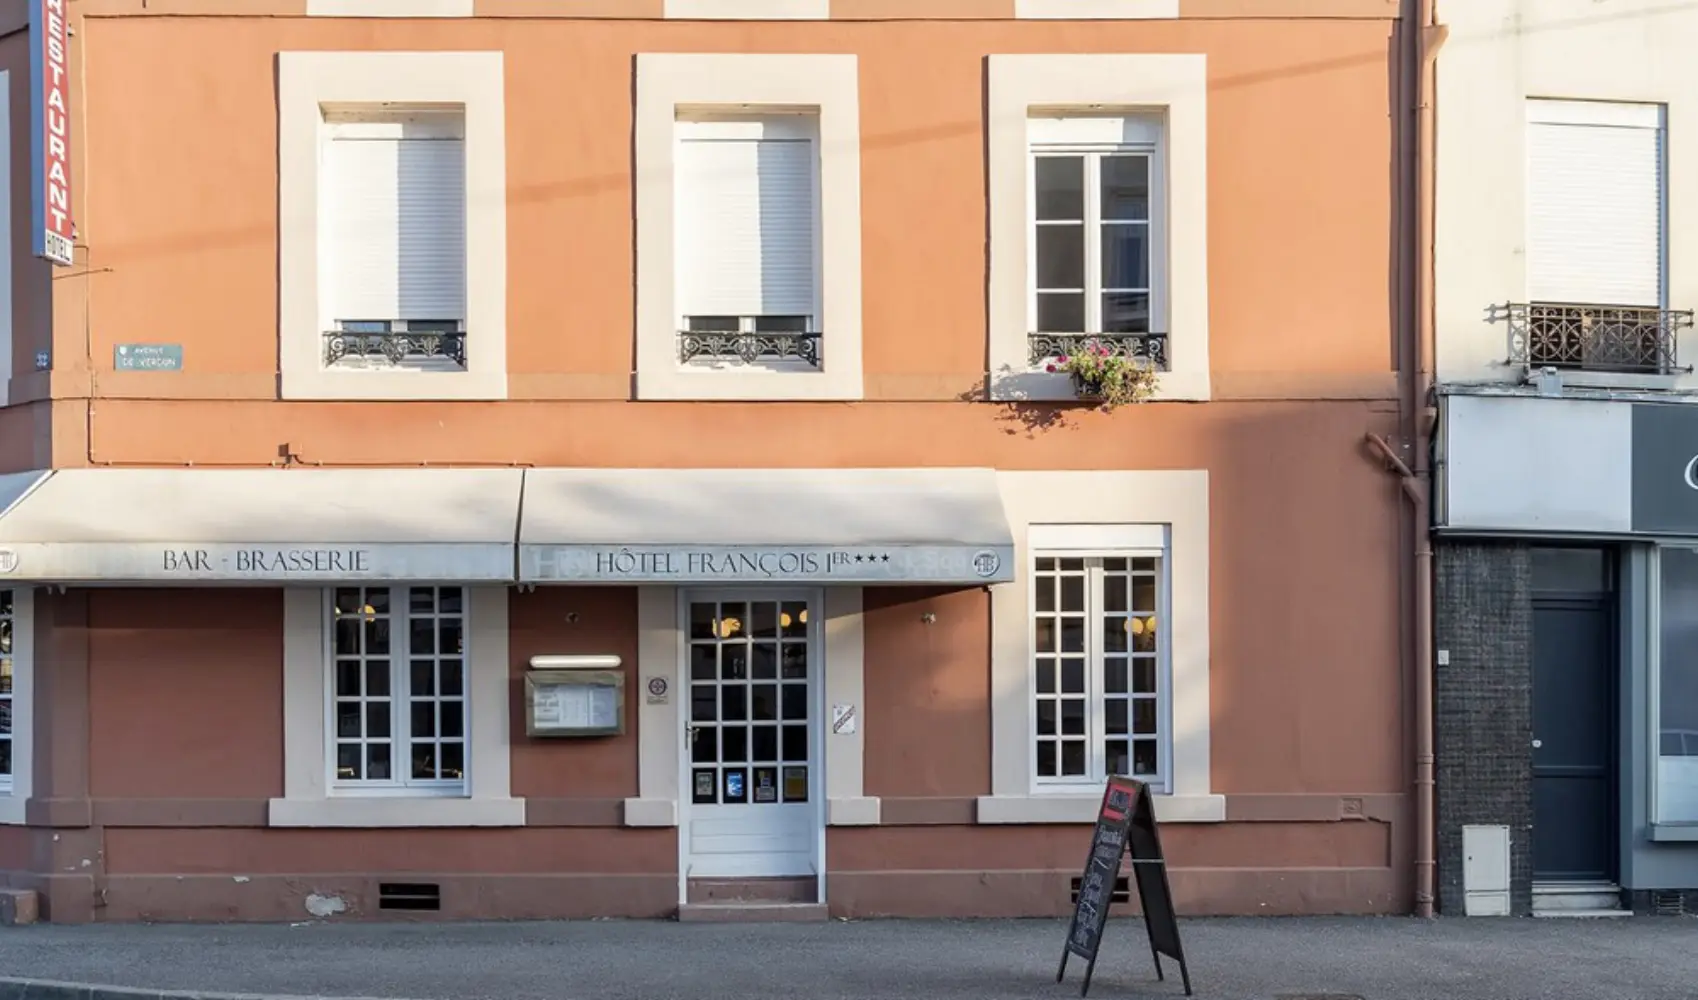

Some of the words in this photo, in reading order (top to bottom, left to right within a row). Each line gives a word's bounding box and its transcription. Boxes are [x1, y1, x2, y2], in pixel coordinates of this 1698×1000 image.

[47, 233, 70, 261] HOTEL
[138, 357, 177, 368] VERDUN
[163, 549, 213, 571] BAR
[236, 549, 370, 571] BRASSERIE
[596, 547, 680, 573] HÔTEL
[687, 551, 820, 577] FRANÇOIS
